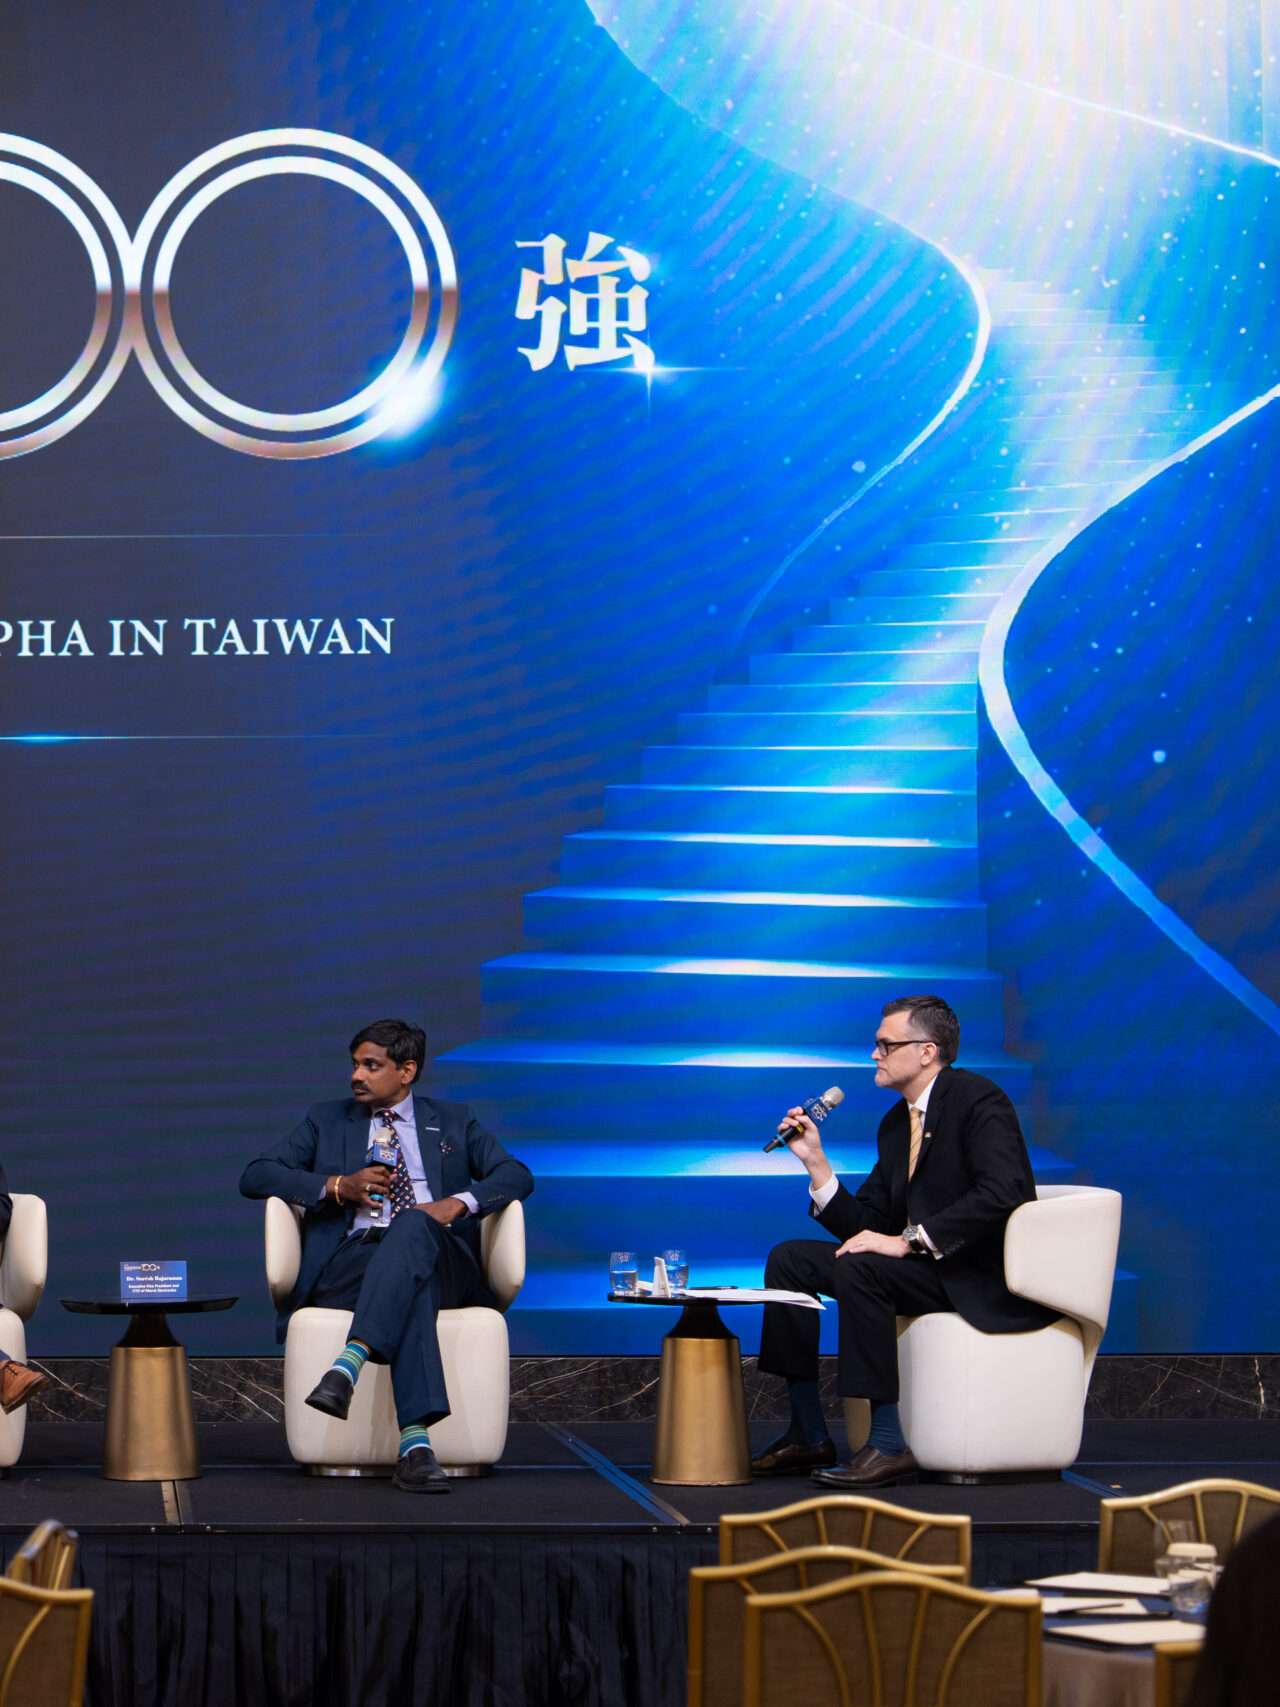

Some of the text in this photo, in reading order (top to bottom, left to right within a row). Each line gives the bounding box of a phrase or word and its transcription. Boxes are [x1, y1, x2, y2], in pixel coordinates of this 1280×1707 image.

[515, 231, 655, 371] 強
[109, 620, 167, 656] IN
[184, 616, 395, 655] TAIWAN
